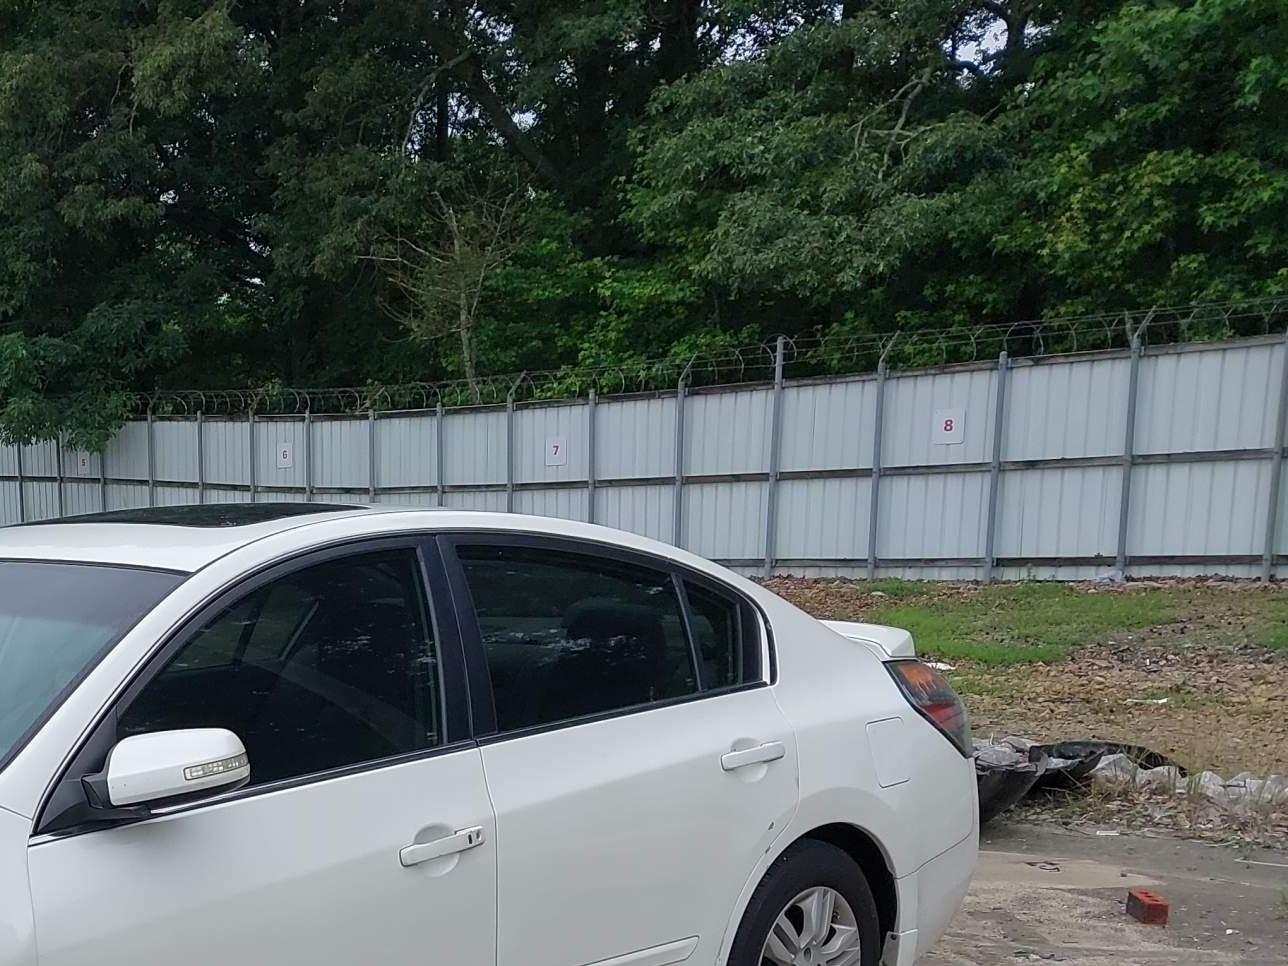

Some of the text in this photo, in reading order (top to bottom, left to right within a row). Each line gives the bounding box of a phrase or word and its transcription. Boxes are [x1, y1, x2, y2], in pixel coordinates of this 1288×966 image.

[943, 419, 953, 432] 8
[282, 450, 289, 460] 6
[552, 445, 560, 456] 7
